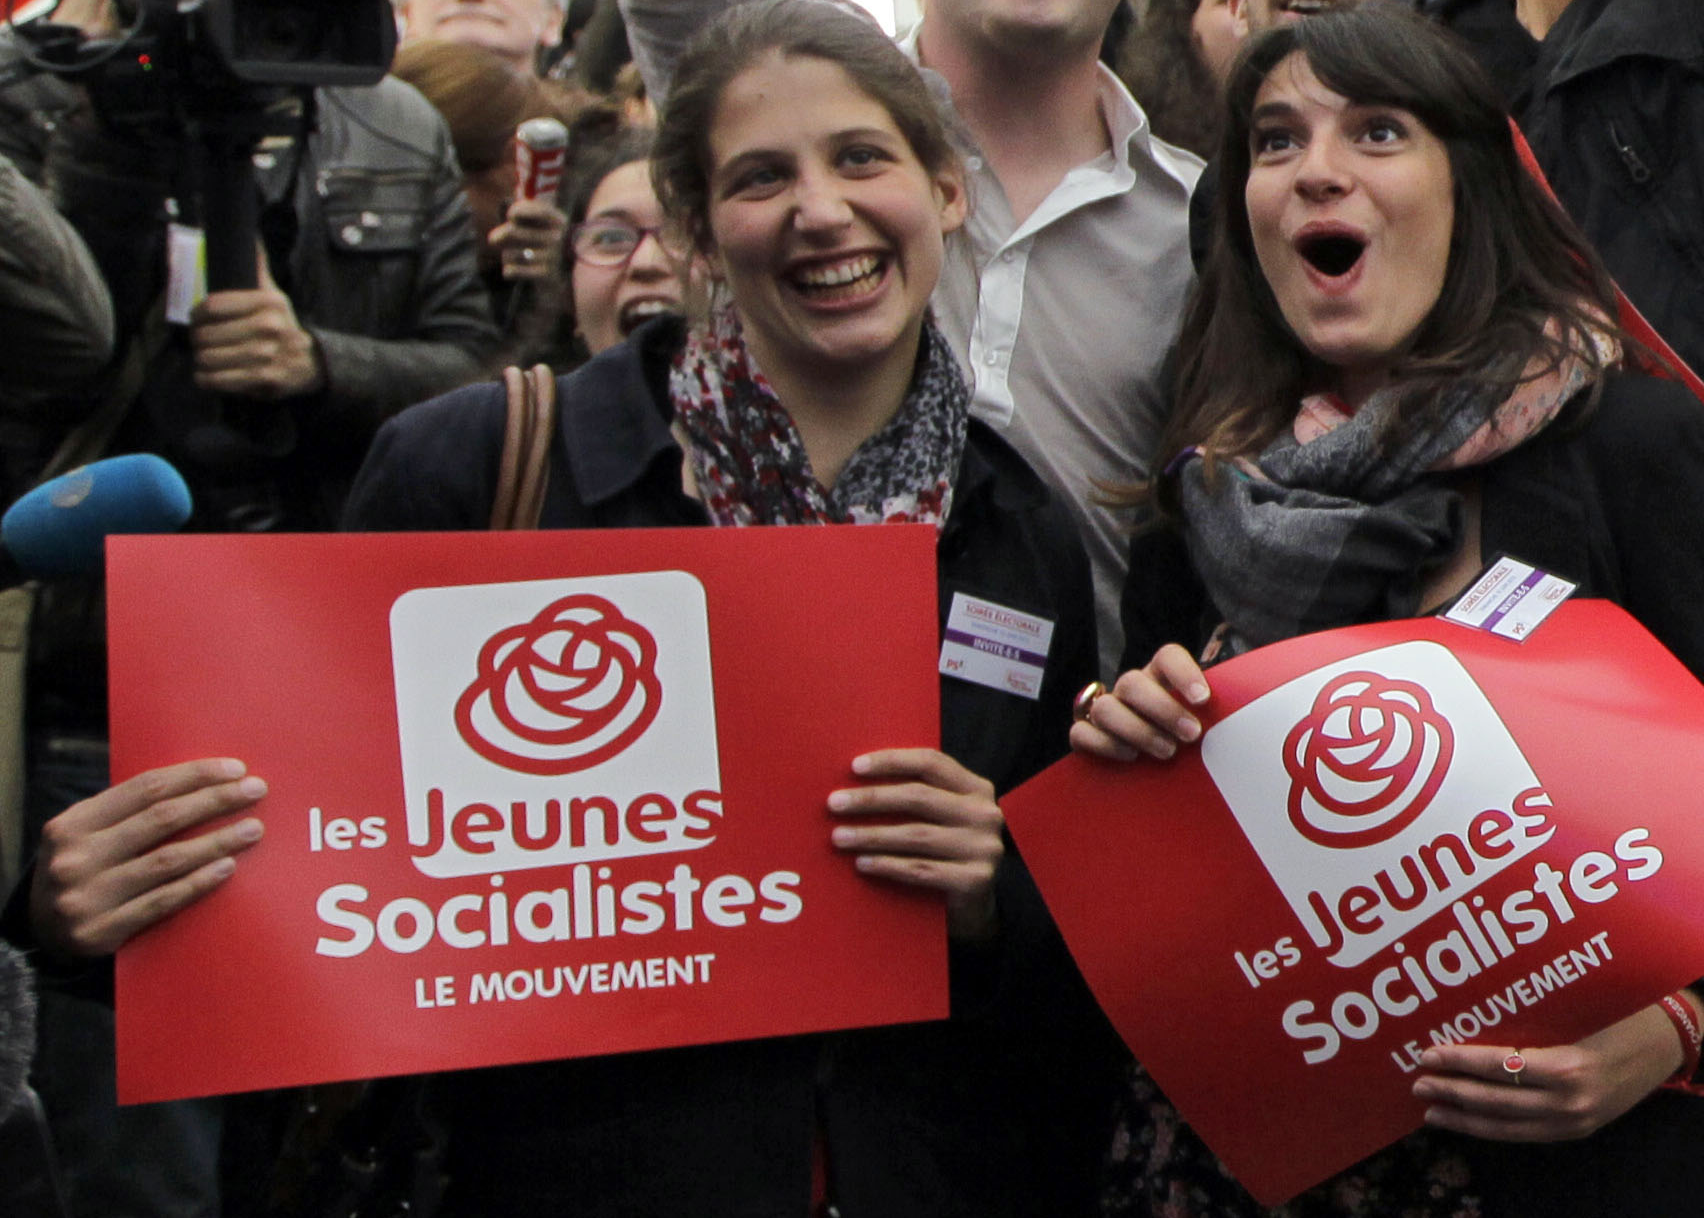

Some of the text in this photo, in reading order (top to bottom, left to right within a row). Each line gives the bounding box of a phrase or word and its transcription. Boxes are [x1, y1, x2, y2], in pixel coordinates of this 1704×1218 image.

[308, 787, 724, 859] les Jeunes
[314, 863, 804, 959] Socialistes
[1234, 786, 1556, 989] les Jeunes
[1282, 827, 1665, 1066] Socialistes
[414, 953, 717, 1009] LE MOUVEMENT
[1391, 931, 1615, 1073] LE MOUVEMENT
